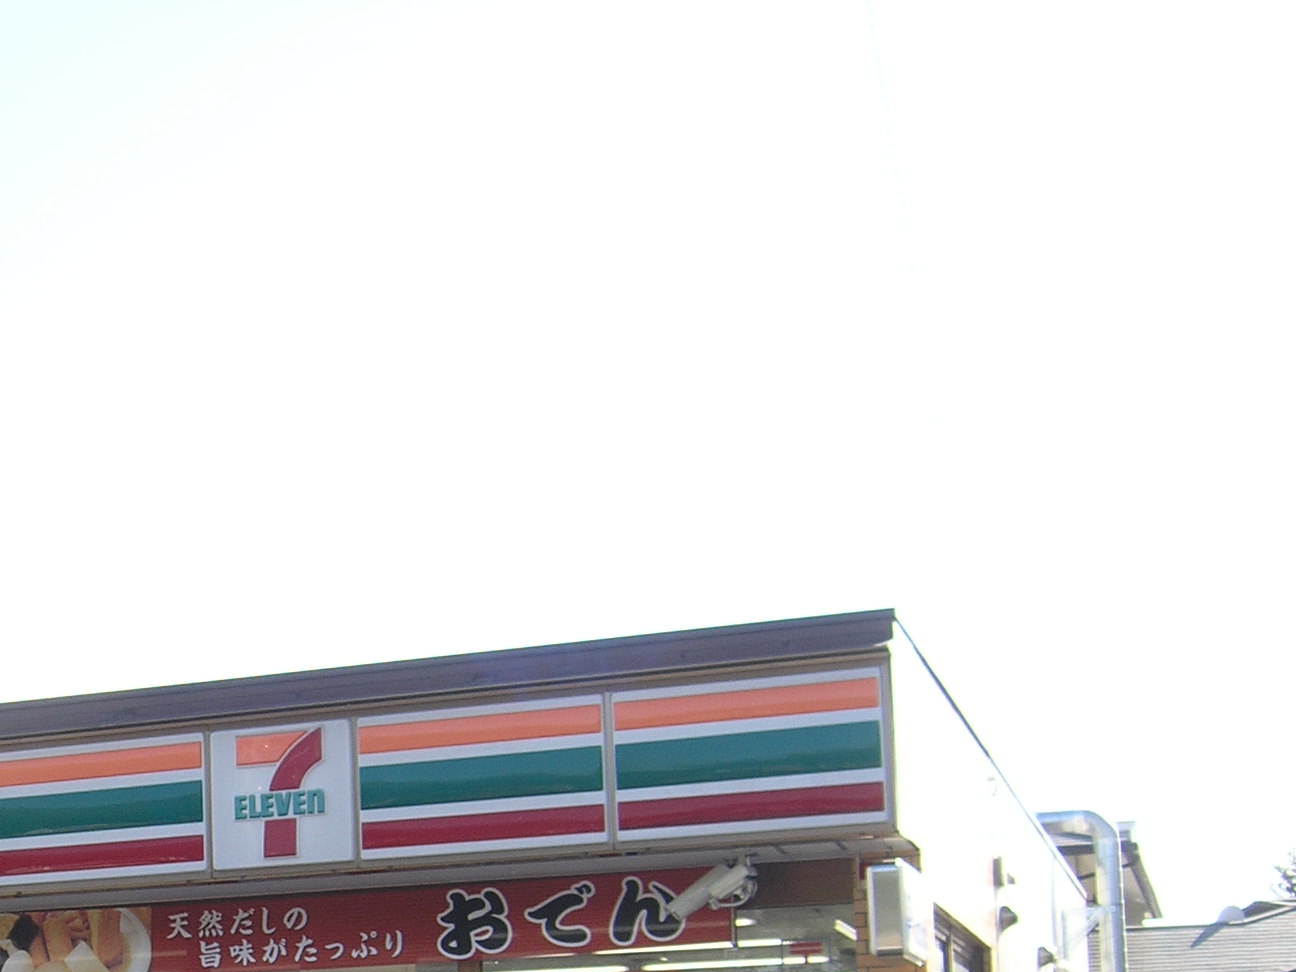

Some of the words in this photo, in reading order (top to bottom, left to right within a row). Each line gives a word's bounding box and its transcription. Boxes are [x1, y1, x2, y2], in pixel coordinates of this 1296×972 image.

[234, 788, 326, 821] ELEVEN
[235, 727, 323, 857] 7
[166, 906, 309, 941] 天然だしの
[437, 877, 687, 961] おでん
[197, 929, 405, 969] 旨味がたっぷり
